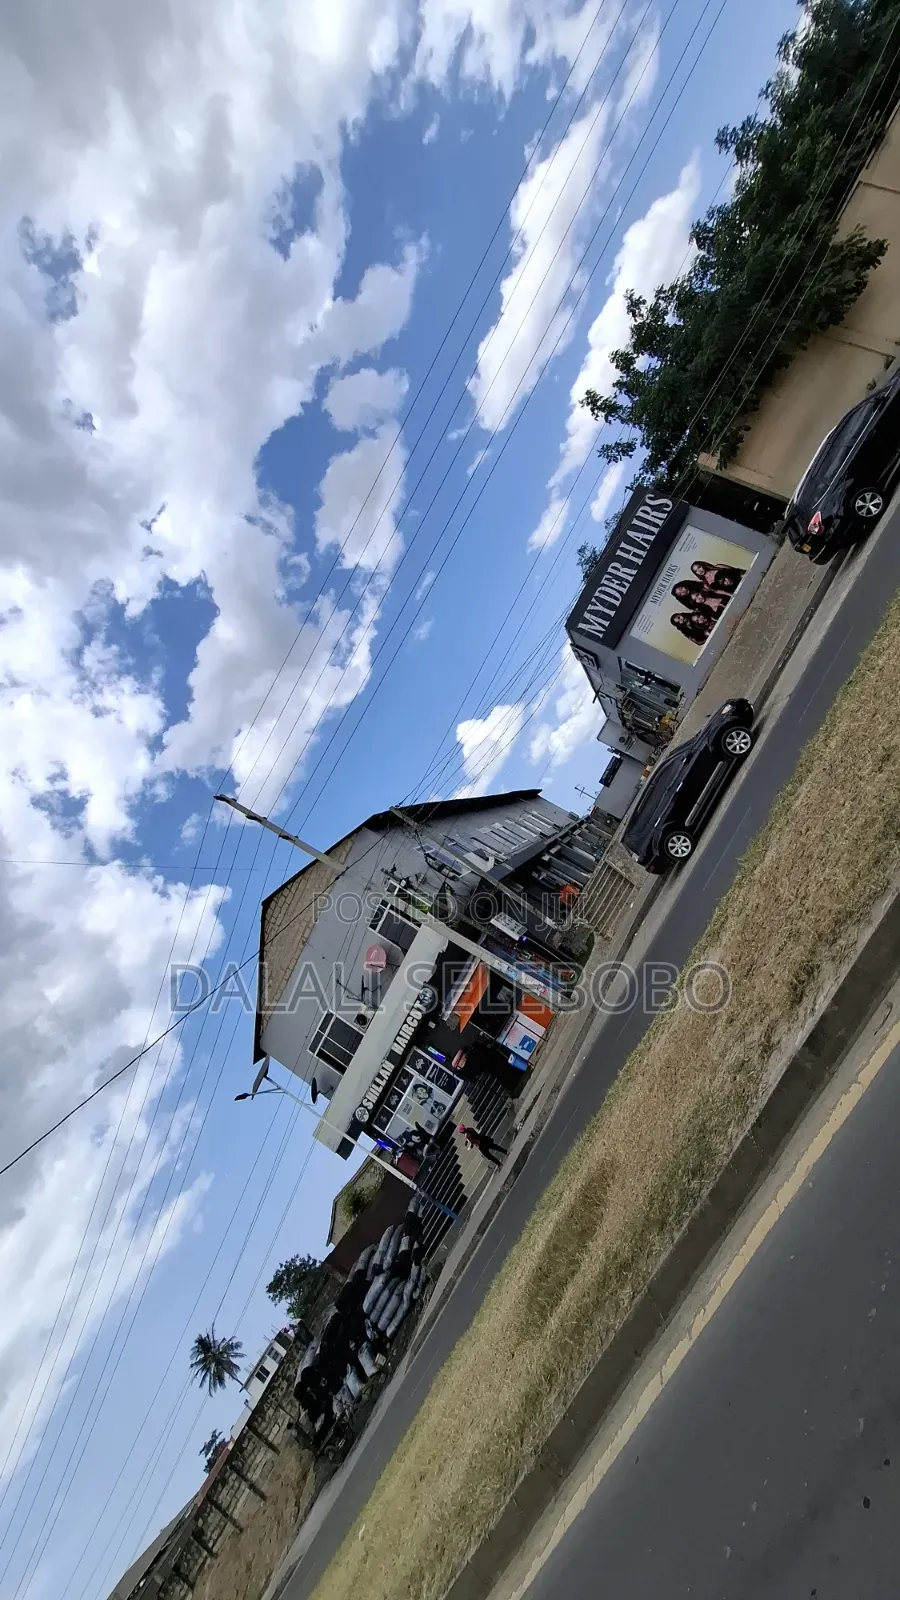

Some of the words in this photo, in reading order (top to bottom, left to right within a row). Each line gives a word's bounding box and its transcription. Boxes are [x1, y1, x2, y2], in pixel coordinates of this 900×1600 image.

[577, 560, 638, 638] MYDER
[615, 494, 673, 565] HAIRS
[650, 582, 667, 606] MYDER
[662, 563, 679, 584] HAIRS
[391, 1000, 427, 1055] HAIRCUT
